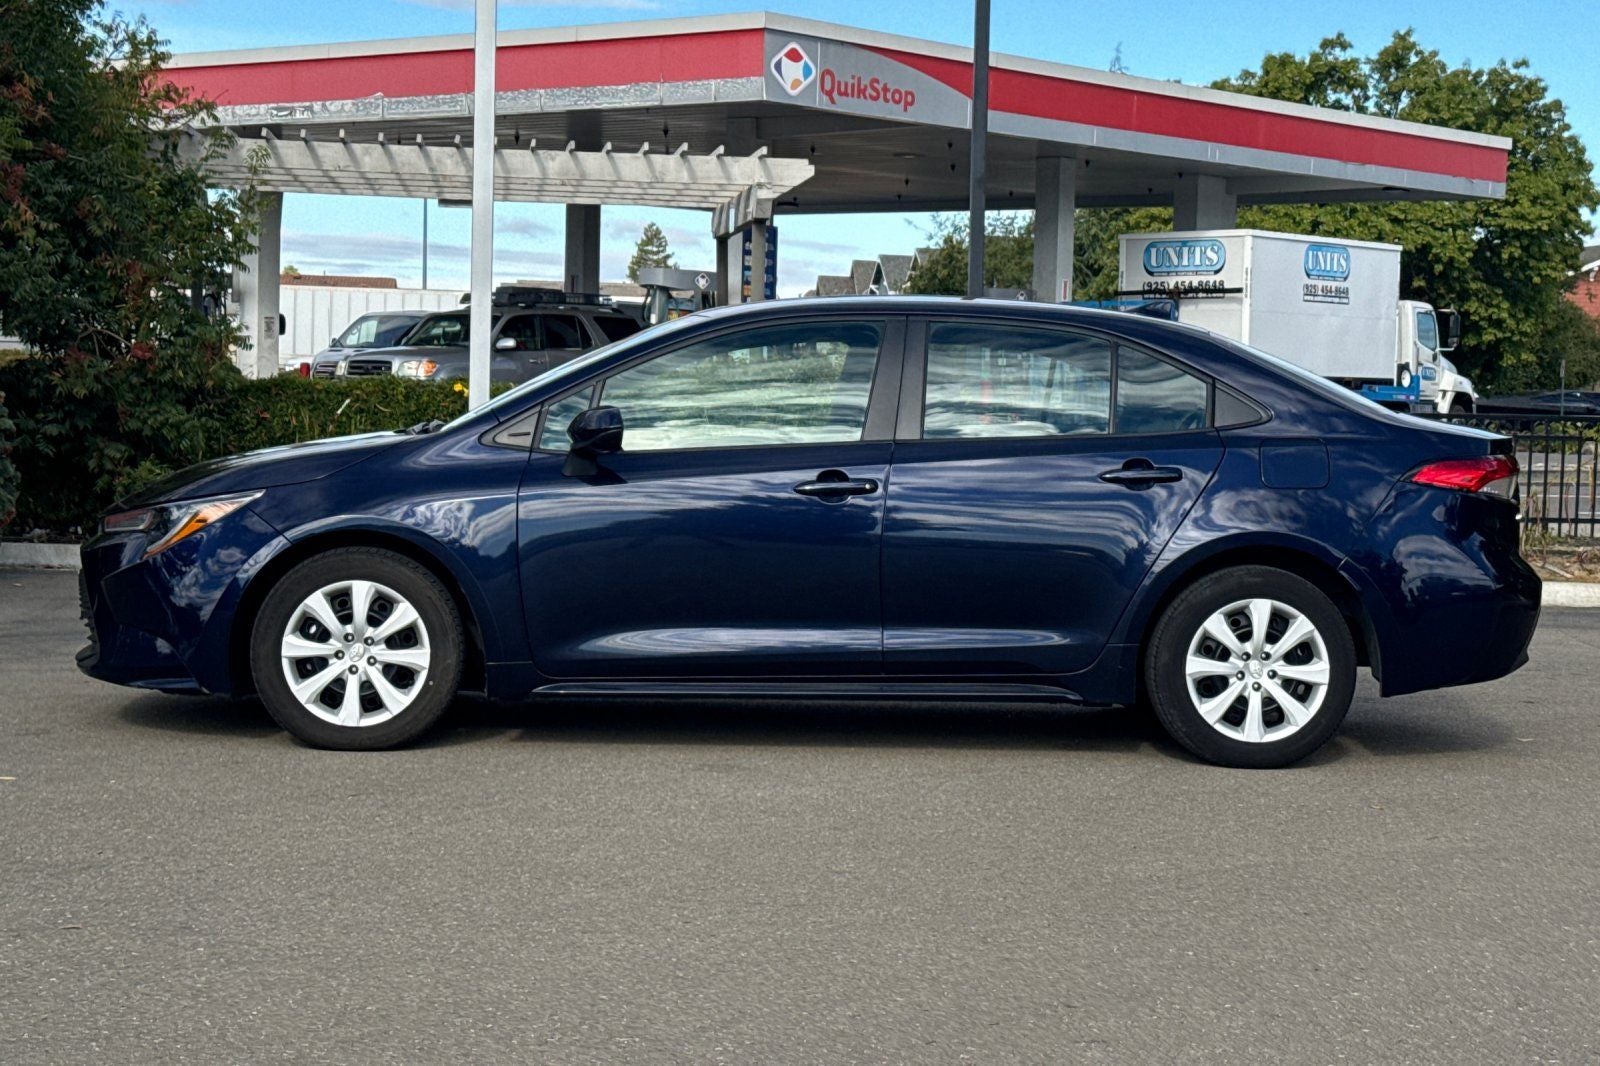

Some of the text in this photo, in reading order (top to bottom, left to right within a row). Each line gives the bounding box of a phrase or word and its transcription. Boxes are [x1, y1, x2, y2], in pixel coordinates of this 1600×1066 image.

[820, 69, 915, 112] QuikStop
[1149, 245, 1219, 267] UNITS
[1308, 250, 1347, 272] UNITS
[1303, 284, 1319, 294] (925)
